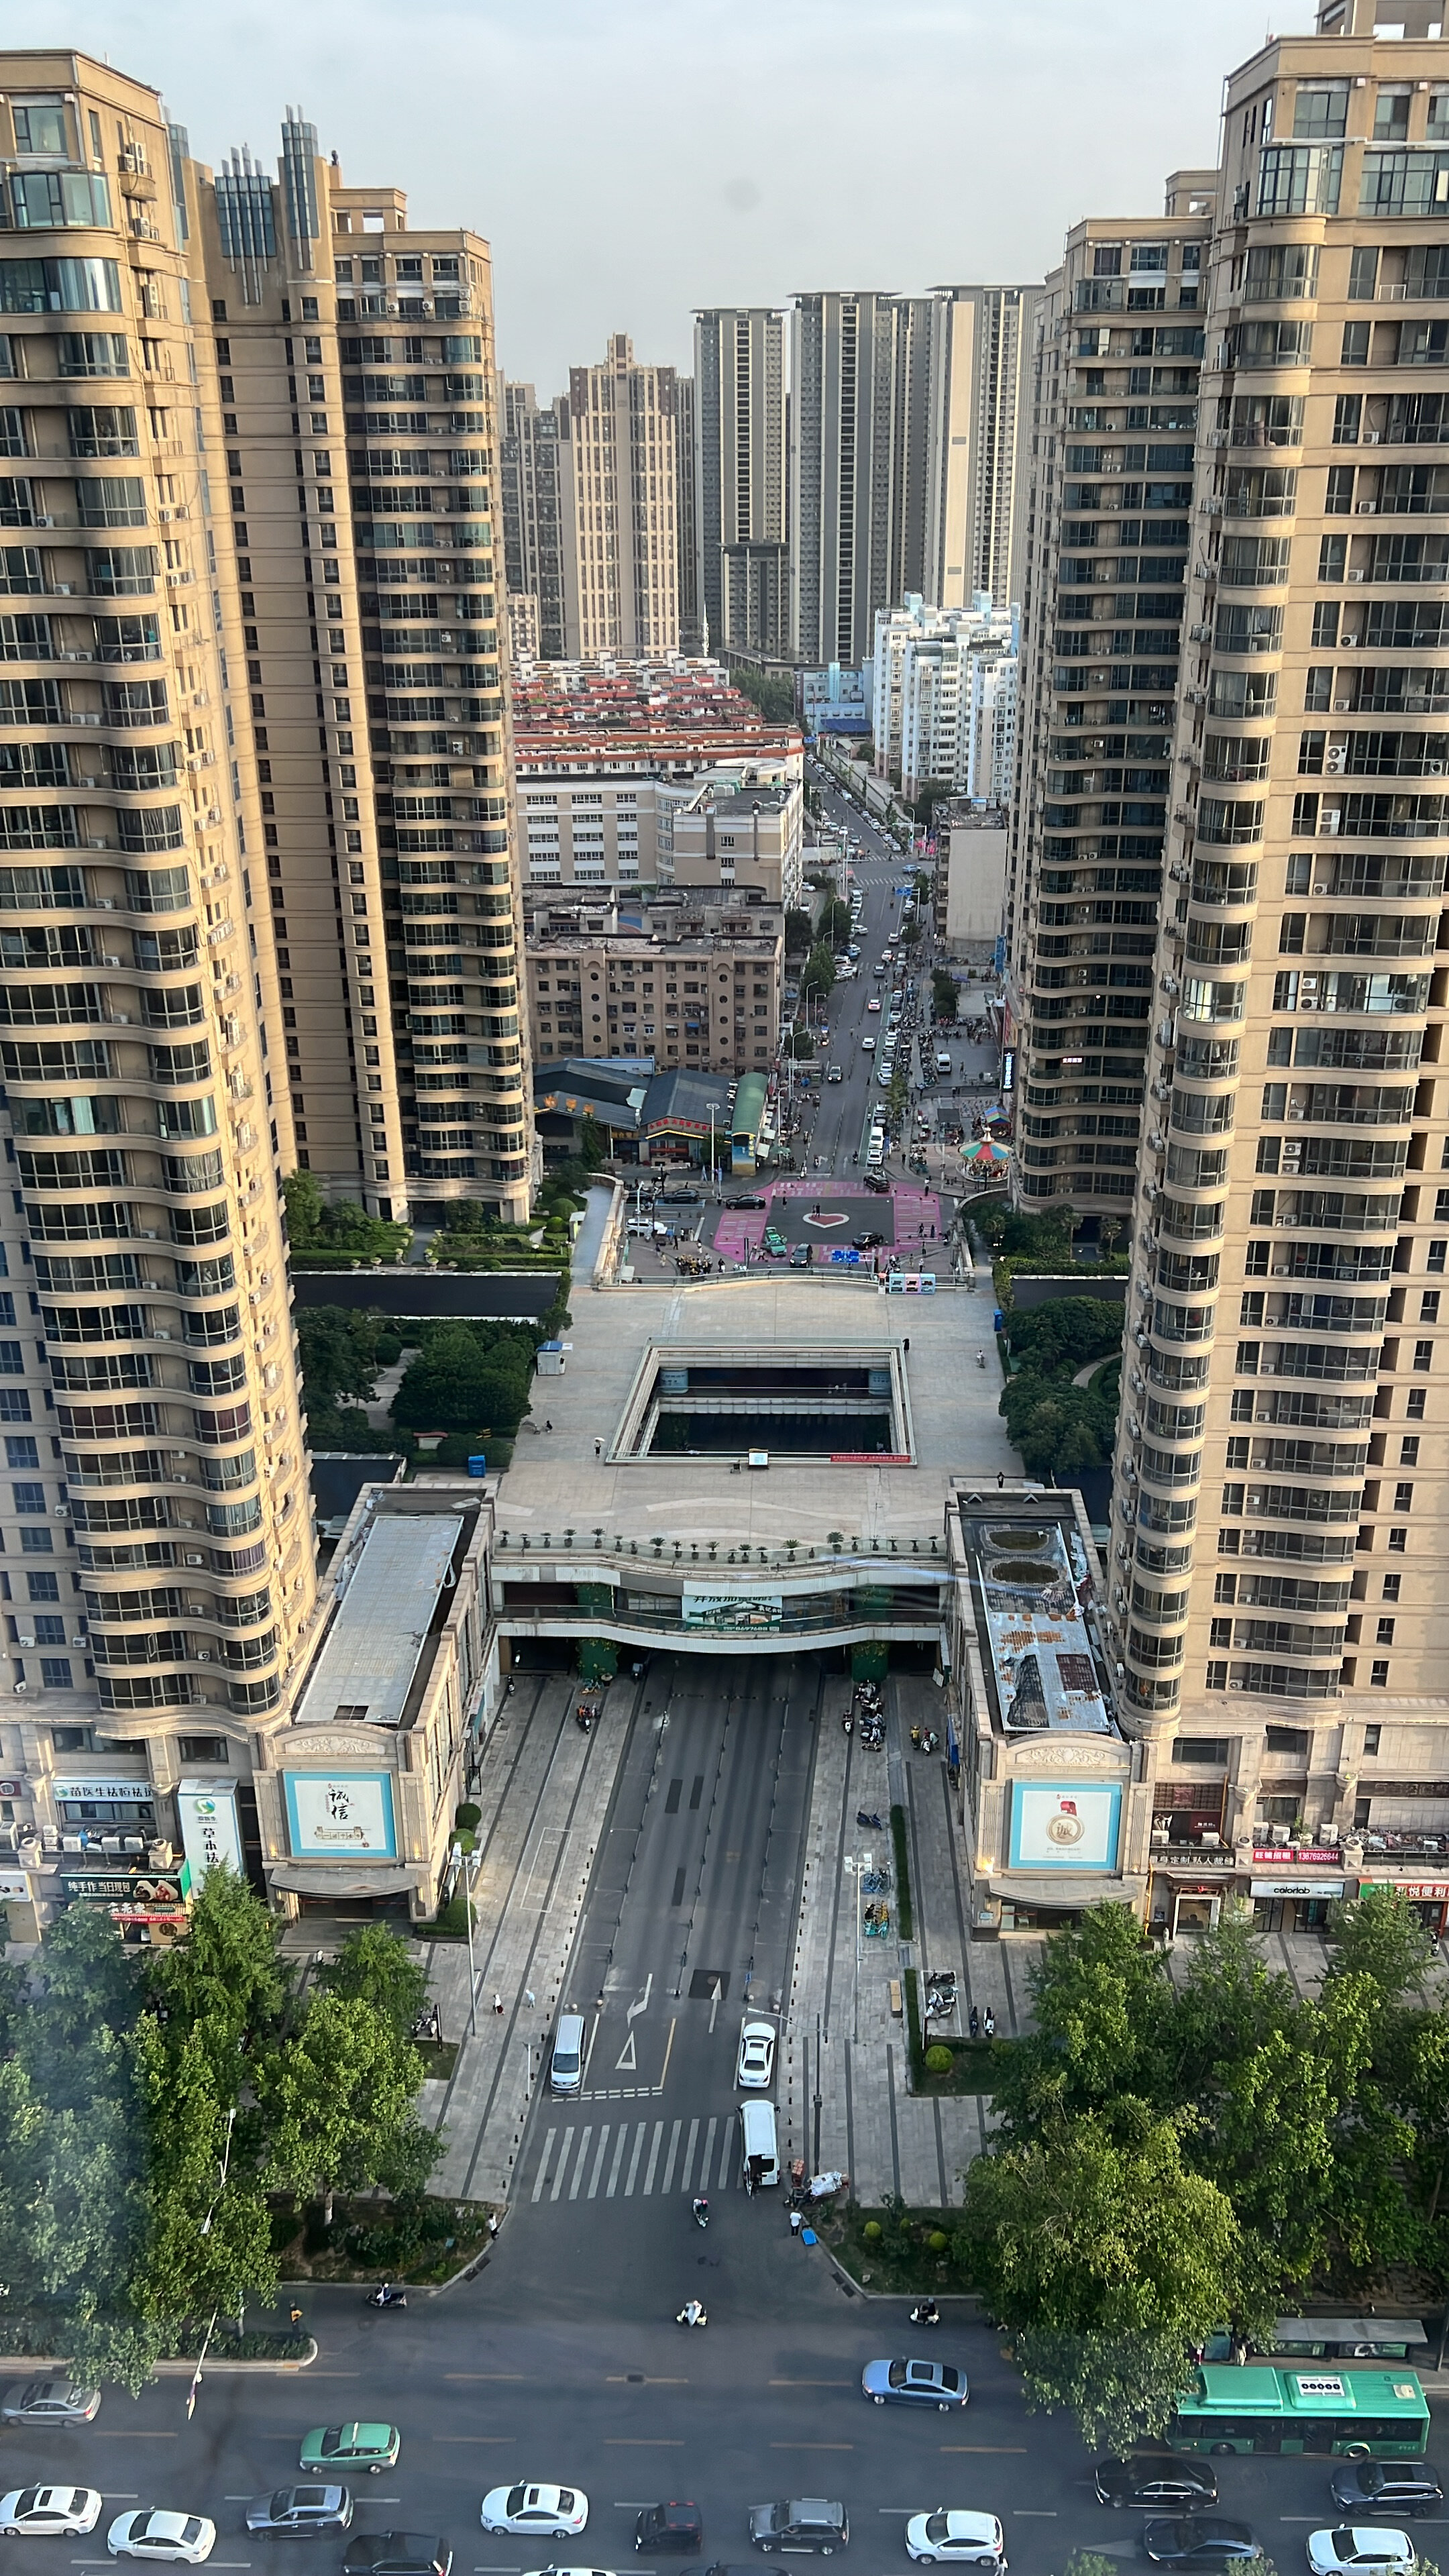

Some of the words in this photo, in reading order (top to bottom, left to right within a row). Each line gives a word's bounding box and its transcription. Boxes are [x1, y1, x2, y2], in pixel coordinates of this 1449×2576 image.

[1255, 1851, 1291, 1860] 旺铺招租
[68, 1882, 97, 1892] 纯手作
[99, 1882, 130, 1892] 当日现包
